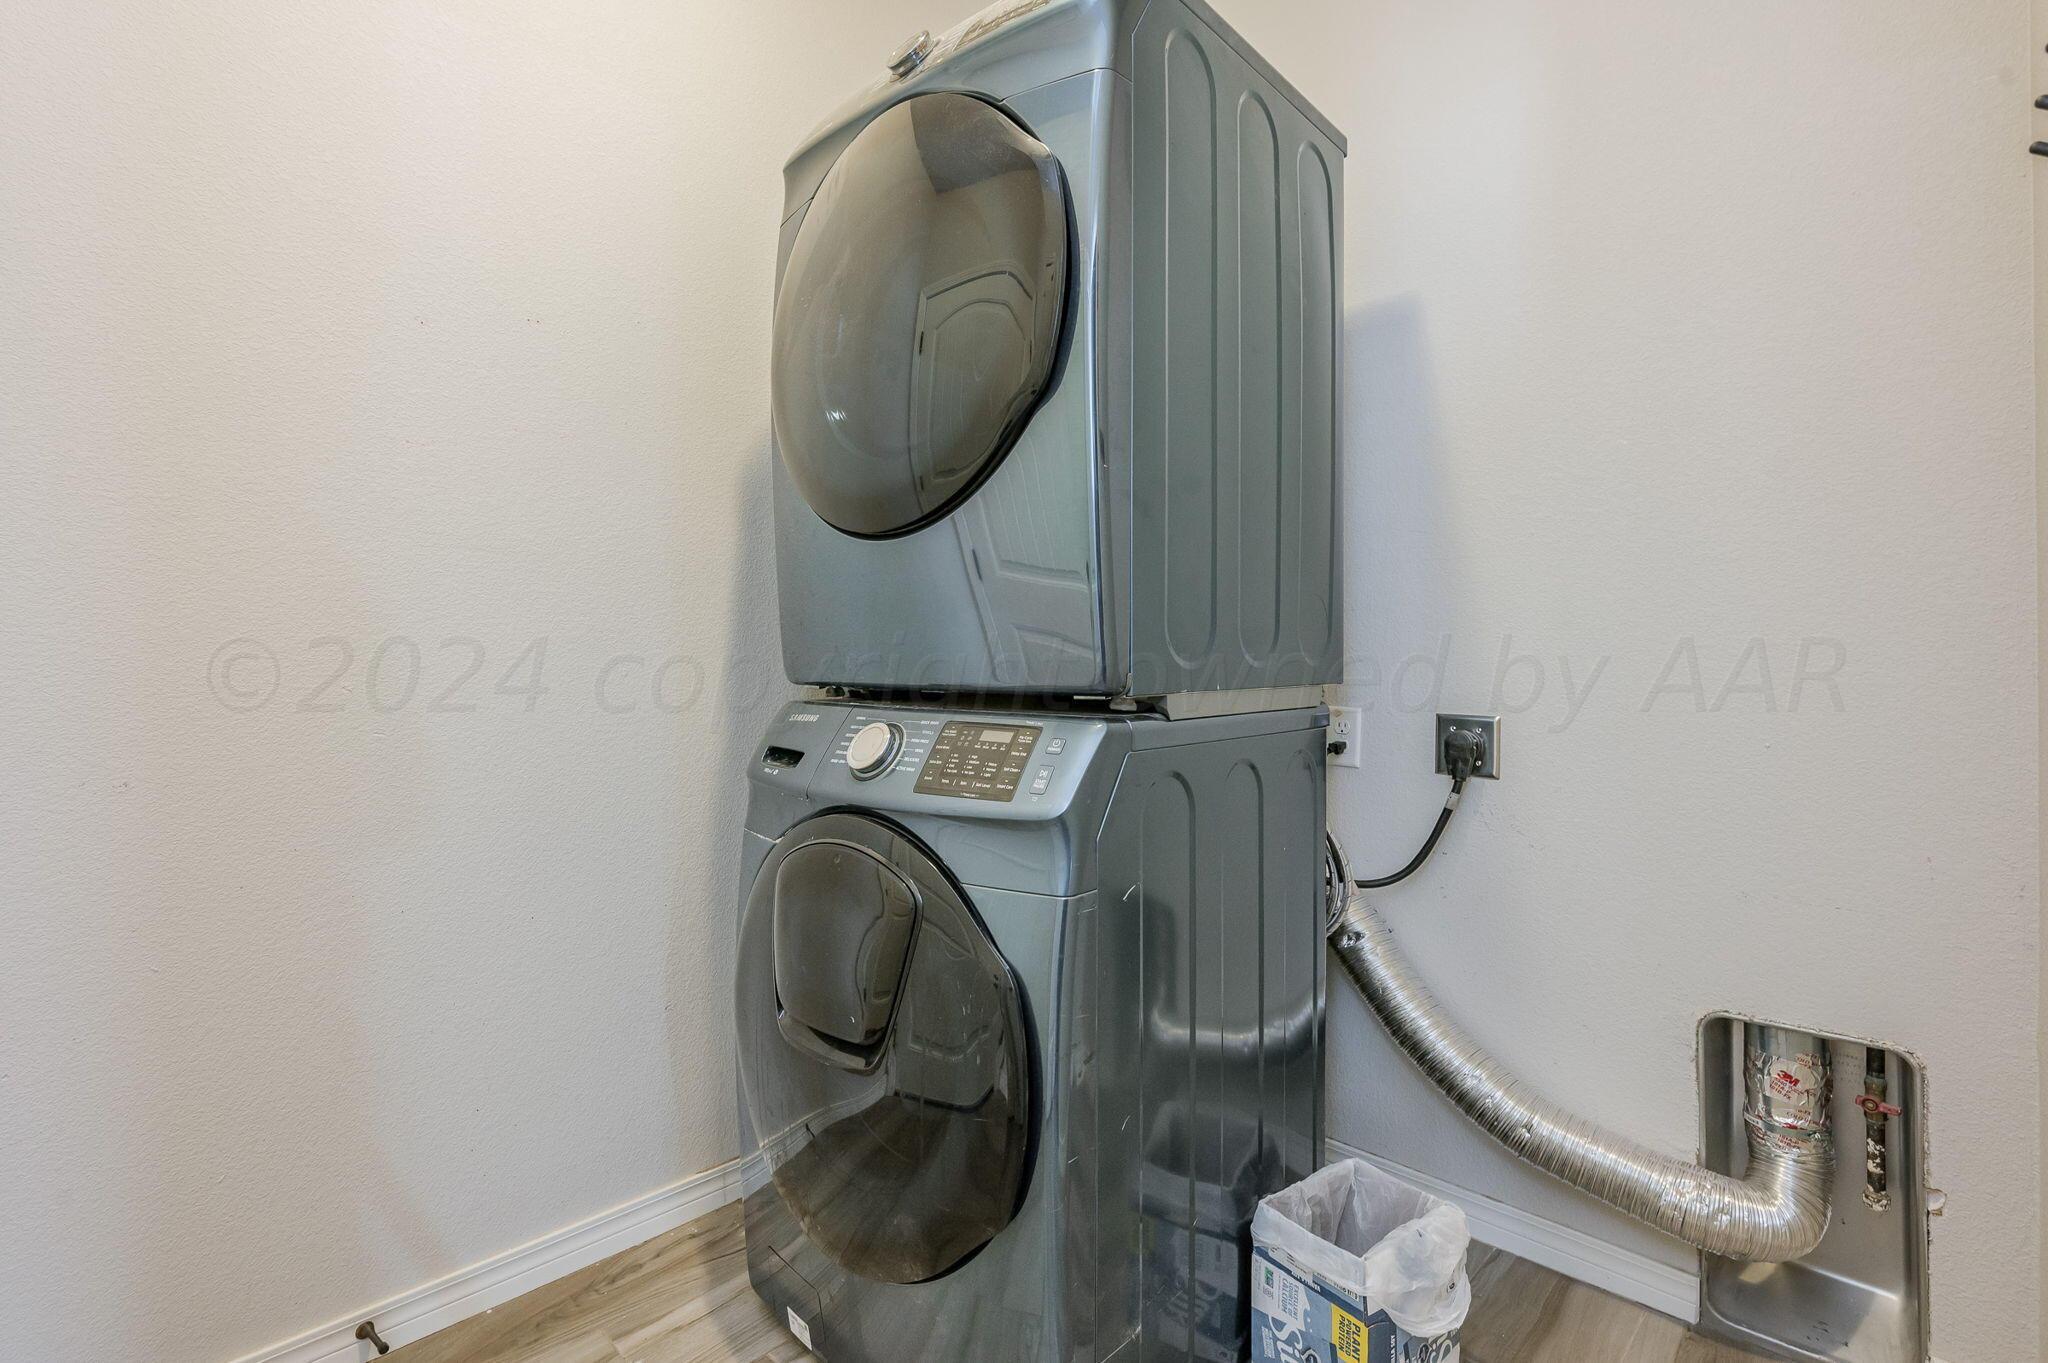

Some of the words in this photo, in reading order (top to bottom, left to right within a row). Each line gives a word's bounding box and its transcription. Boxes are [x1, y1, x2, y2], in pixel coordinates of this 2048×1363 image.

[789, 713, 820, 722] SAMSUNG
[1776, 1069, 1801, 1087] 3M
[1280, 1277, 1289, 1315] CALCIUM
[1292, 1284, 1300, 1321] EXCELLENT
[1344, 1318, 1352, 1357] POWERED
[1351, 1322, 1361, 1362] PLANT
